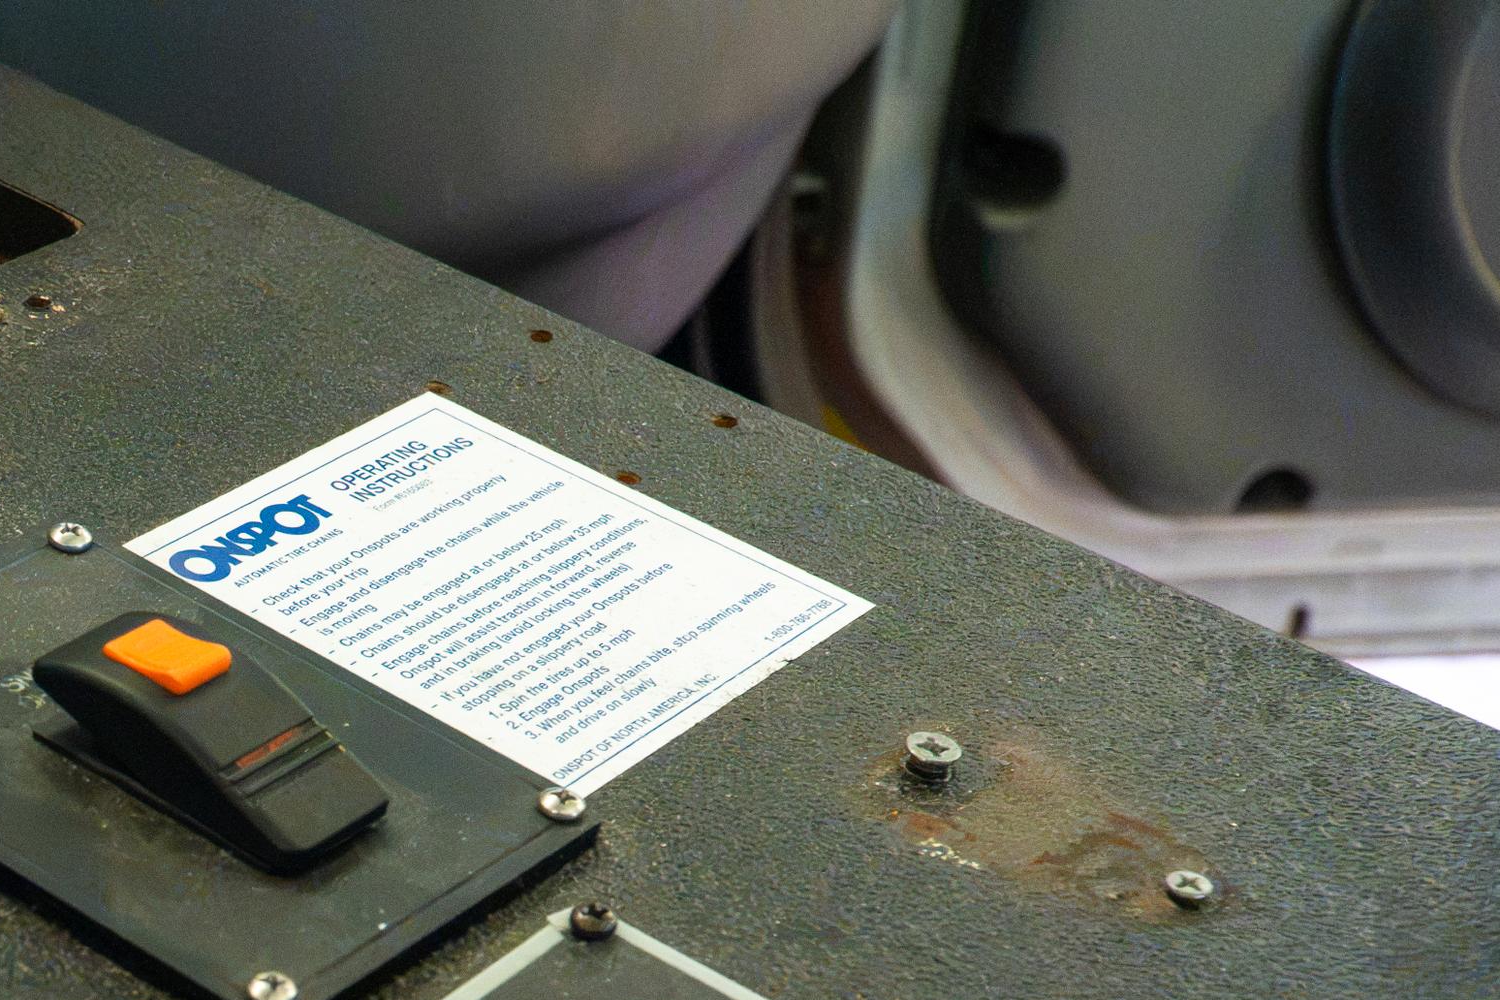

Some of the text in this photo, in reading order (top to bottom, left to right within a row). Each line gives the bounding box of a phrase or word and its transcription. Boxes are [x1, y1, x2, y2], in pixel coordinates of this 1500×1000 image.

[330, 440, 428, 491] OPERATING
[349, 437, 473, 502] INSTRUCTIONS
[169, 495, 331, 583] ONSPOT
[234, 528, 344, 588] AUTOMATIC TIRE CHAINS
[262, 474, 507, 606] Check that your Onspots are working properly
[299, 481, 565, 627] Engage and disengage the chains while the vehicle
[339, 518, 568, 647] Chains may be engaged at or below 25 mph
[278, 567, 369, 616] before your trip
[316, 603, 378, 637] is moving
[360, 513, 615, 659] Chains should be disengaged at or below 35 mph
[380, 643, 430, 671] Engage
[427, 621, 467, 645] chains
[461, 600, 503, 624] before
[500, 573, 552, 603] reaching
[547, 548, 593, 576] slippery
[399, 652, 448, 679] Onspot
[443, 639, 468, 655] will
[464, 620, 501, 644] assist
[495, 596, 544, 624] traction
[537, 589, 556, 599] in
[595, 541, 637, 566] reverse
[419, 562, 633, 690] and in braking (avoid locking the wheels)
[439, 563, 673, 702] If you have not engaged your Onspots before
[461, 620, 608, 712] stopping on a slippery road
[498, 694, 530, 713] Spin
[525, 682, 549, 697] the
[544, 666, 575, 684] tires
[572, 657, 590, 669] up
[586, 649, 603, 660] to
[598, 642, 612, 652] 5
[608, 629, 636, 647] mph
[535, 709, 574, 732] When
[570, 695, 597, 714] you
[588, 680, 617, 699] feel
[613, 660, 652, 685] chains
[672, 630, 699, 648] stop
[696, 603, 744, 633] spinning
[738, 582, 776, 606] wheels
[518, 693, 565, 722] Engage
[560, 665, 610, 695] Onspots
[555, 677, 657, 744] and drive on slowly
[552, 748, 599, 780] ONSPOT
[595, 738, 613, 752] OF
[609, 716, 652, 743] NORTH
